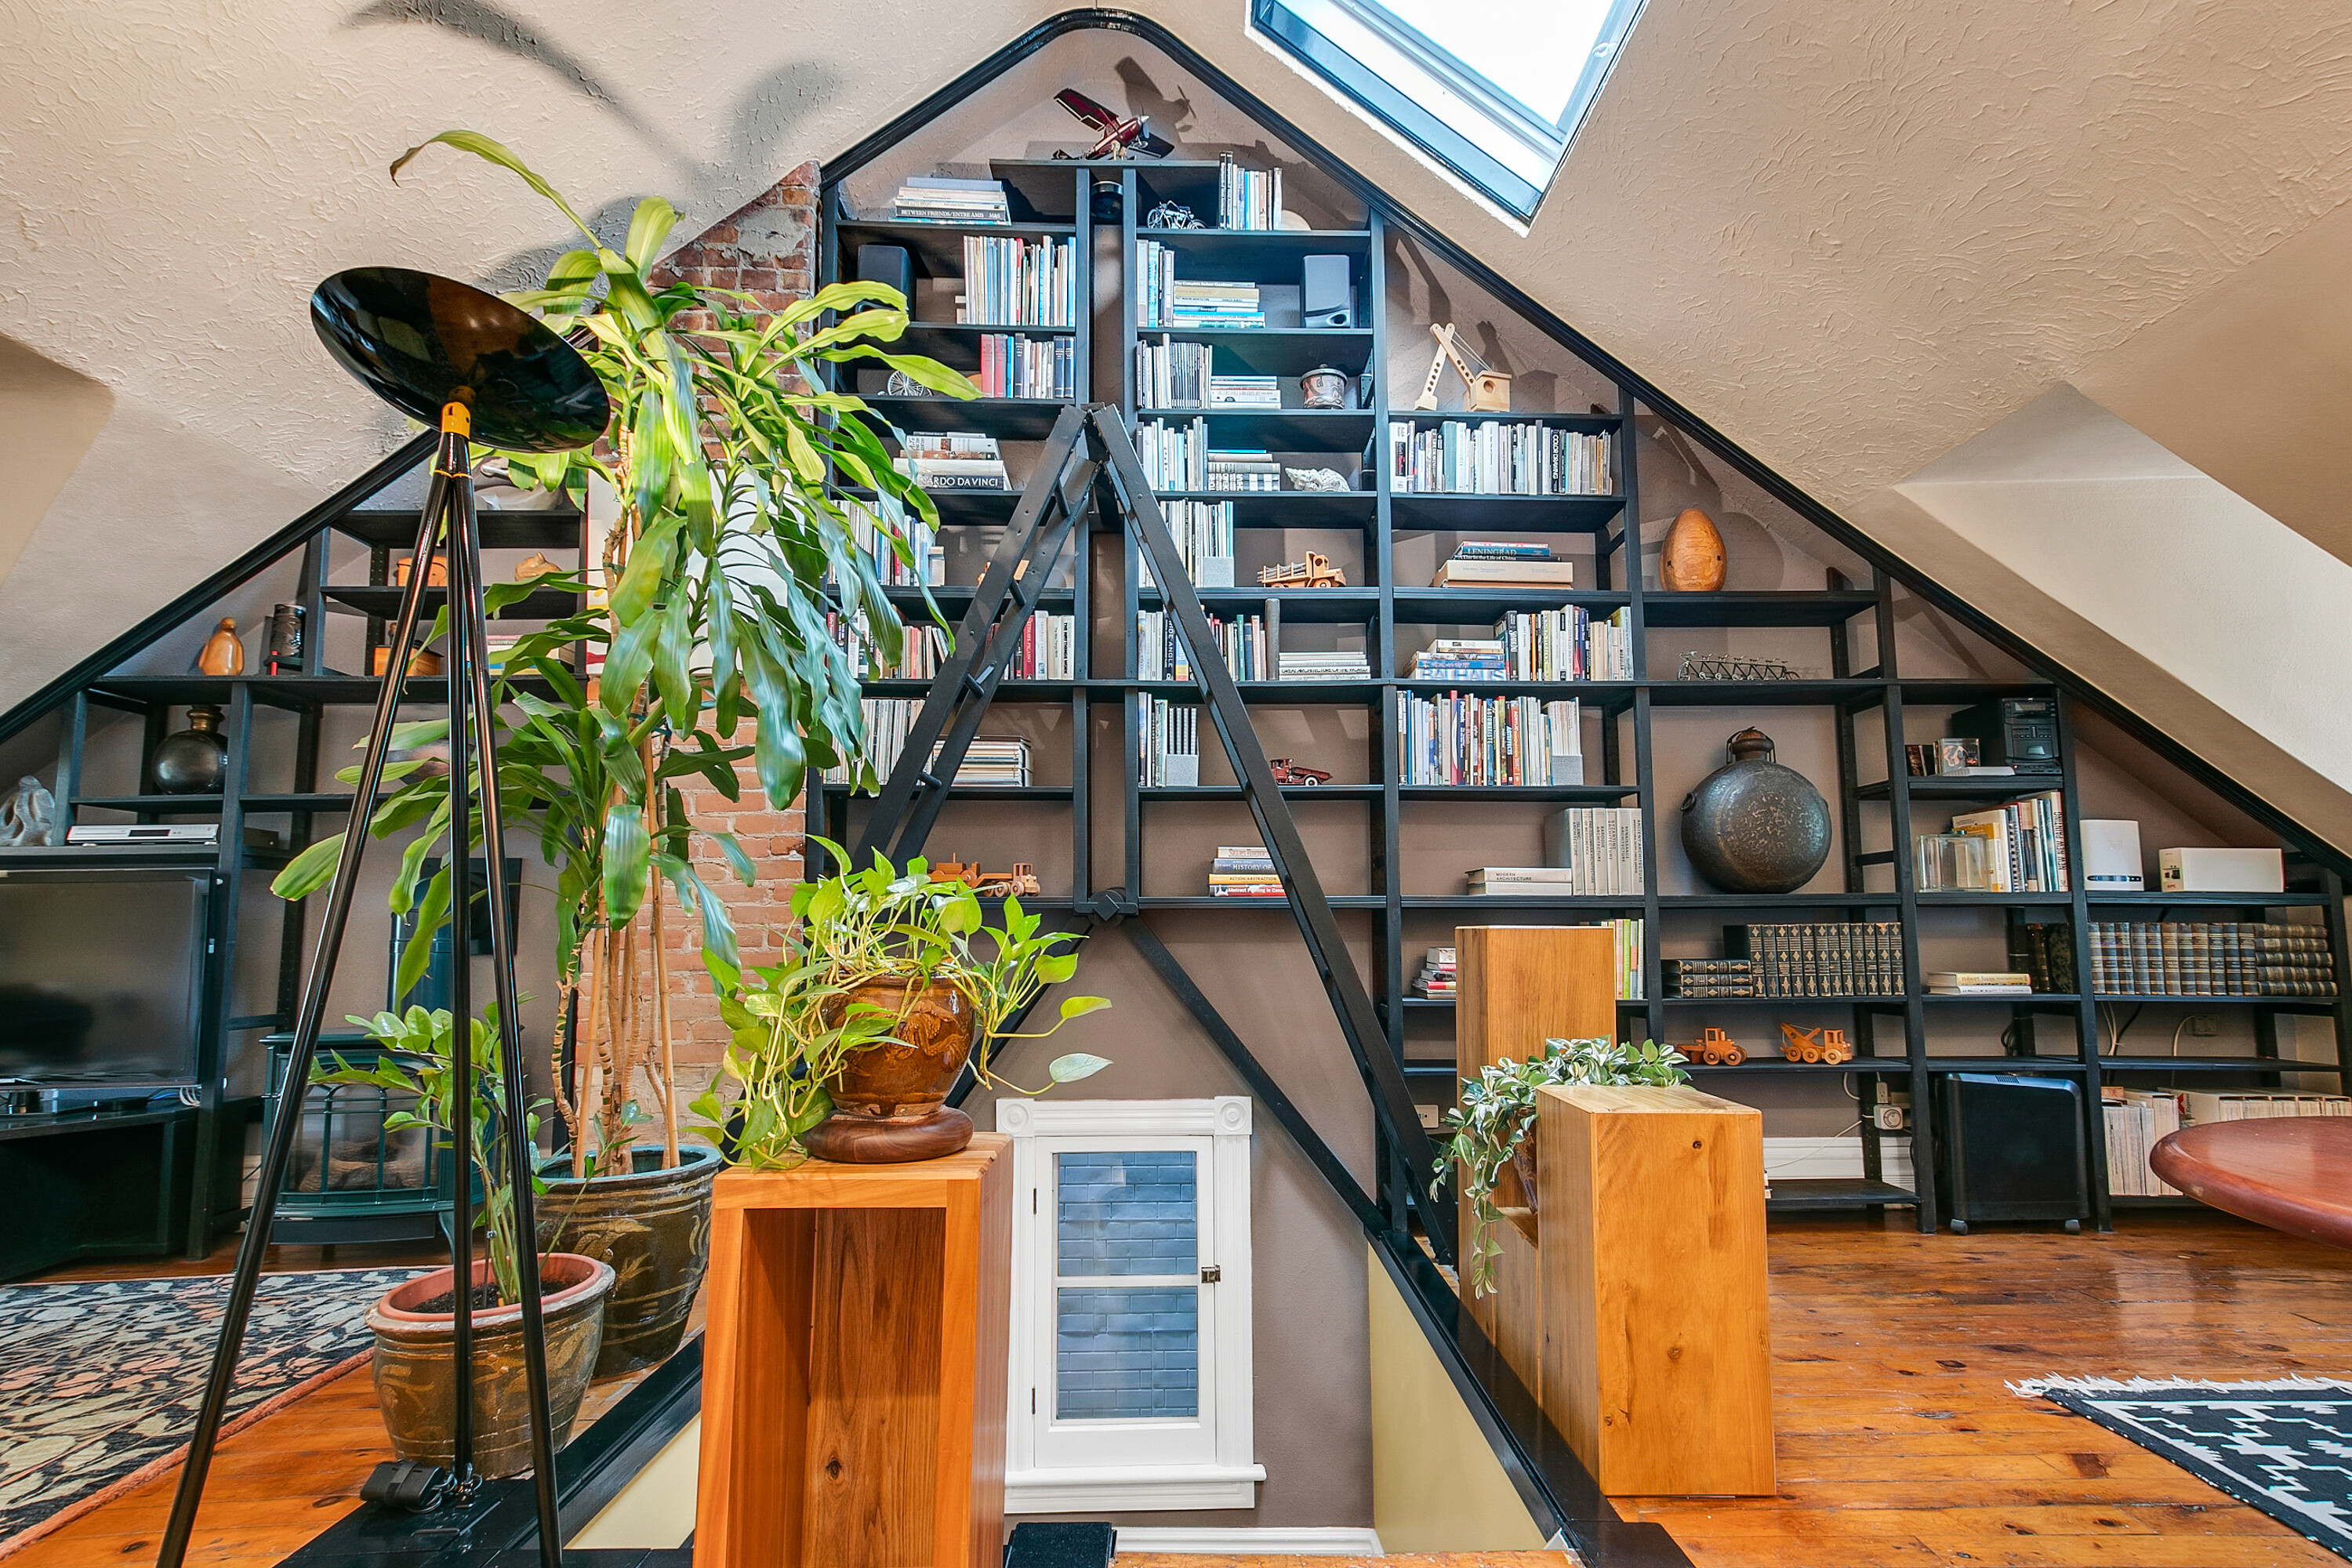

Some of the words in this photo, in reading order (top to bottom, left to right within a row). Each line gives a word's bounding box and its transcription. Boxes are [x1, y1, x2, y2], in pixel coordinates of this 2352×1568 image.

[919, 477, 956, 487] NARDO
[957, 477, 971, 486] DA
[971, 477, 999, 487] VINCI
[1468, 547, 1517, 556] LENINGRAD
[2054, 811, 2064, 839] PAINTING
[2056, 840, 2066, 855] NEW
[2058, 857, 2067, 870] NEW
